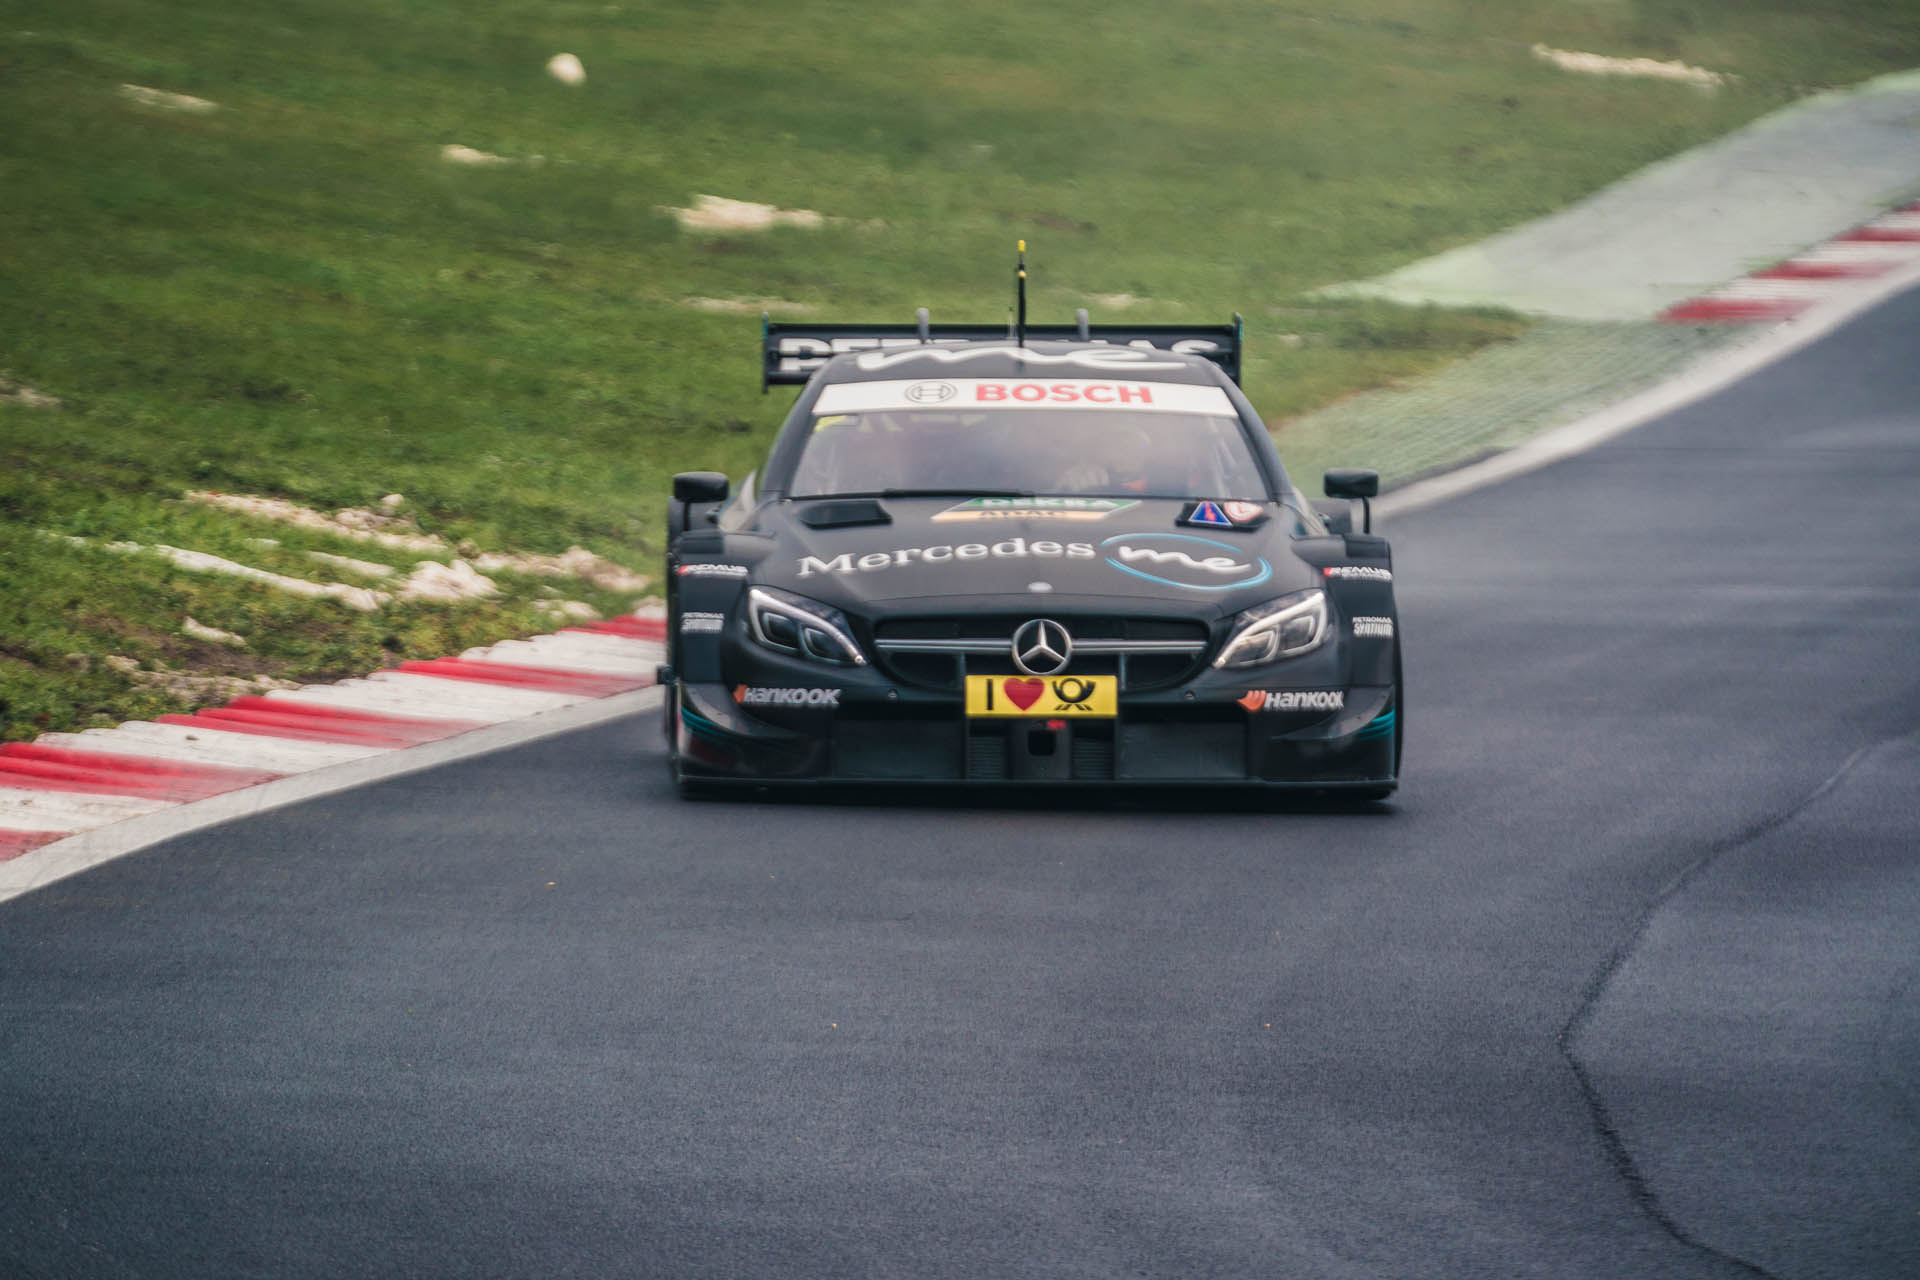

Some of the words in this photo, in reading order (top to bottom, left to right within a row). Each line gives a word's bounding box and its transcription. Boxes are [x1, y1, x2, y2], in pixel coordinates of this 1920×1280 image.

[977, 384, 1153, 404] BOSCH
[796, 537, 1097, 577] Mercedes
[1117, 544, 1252, 574] me
